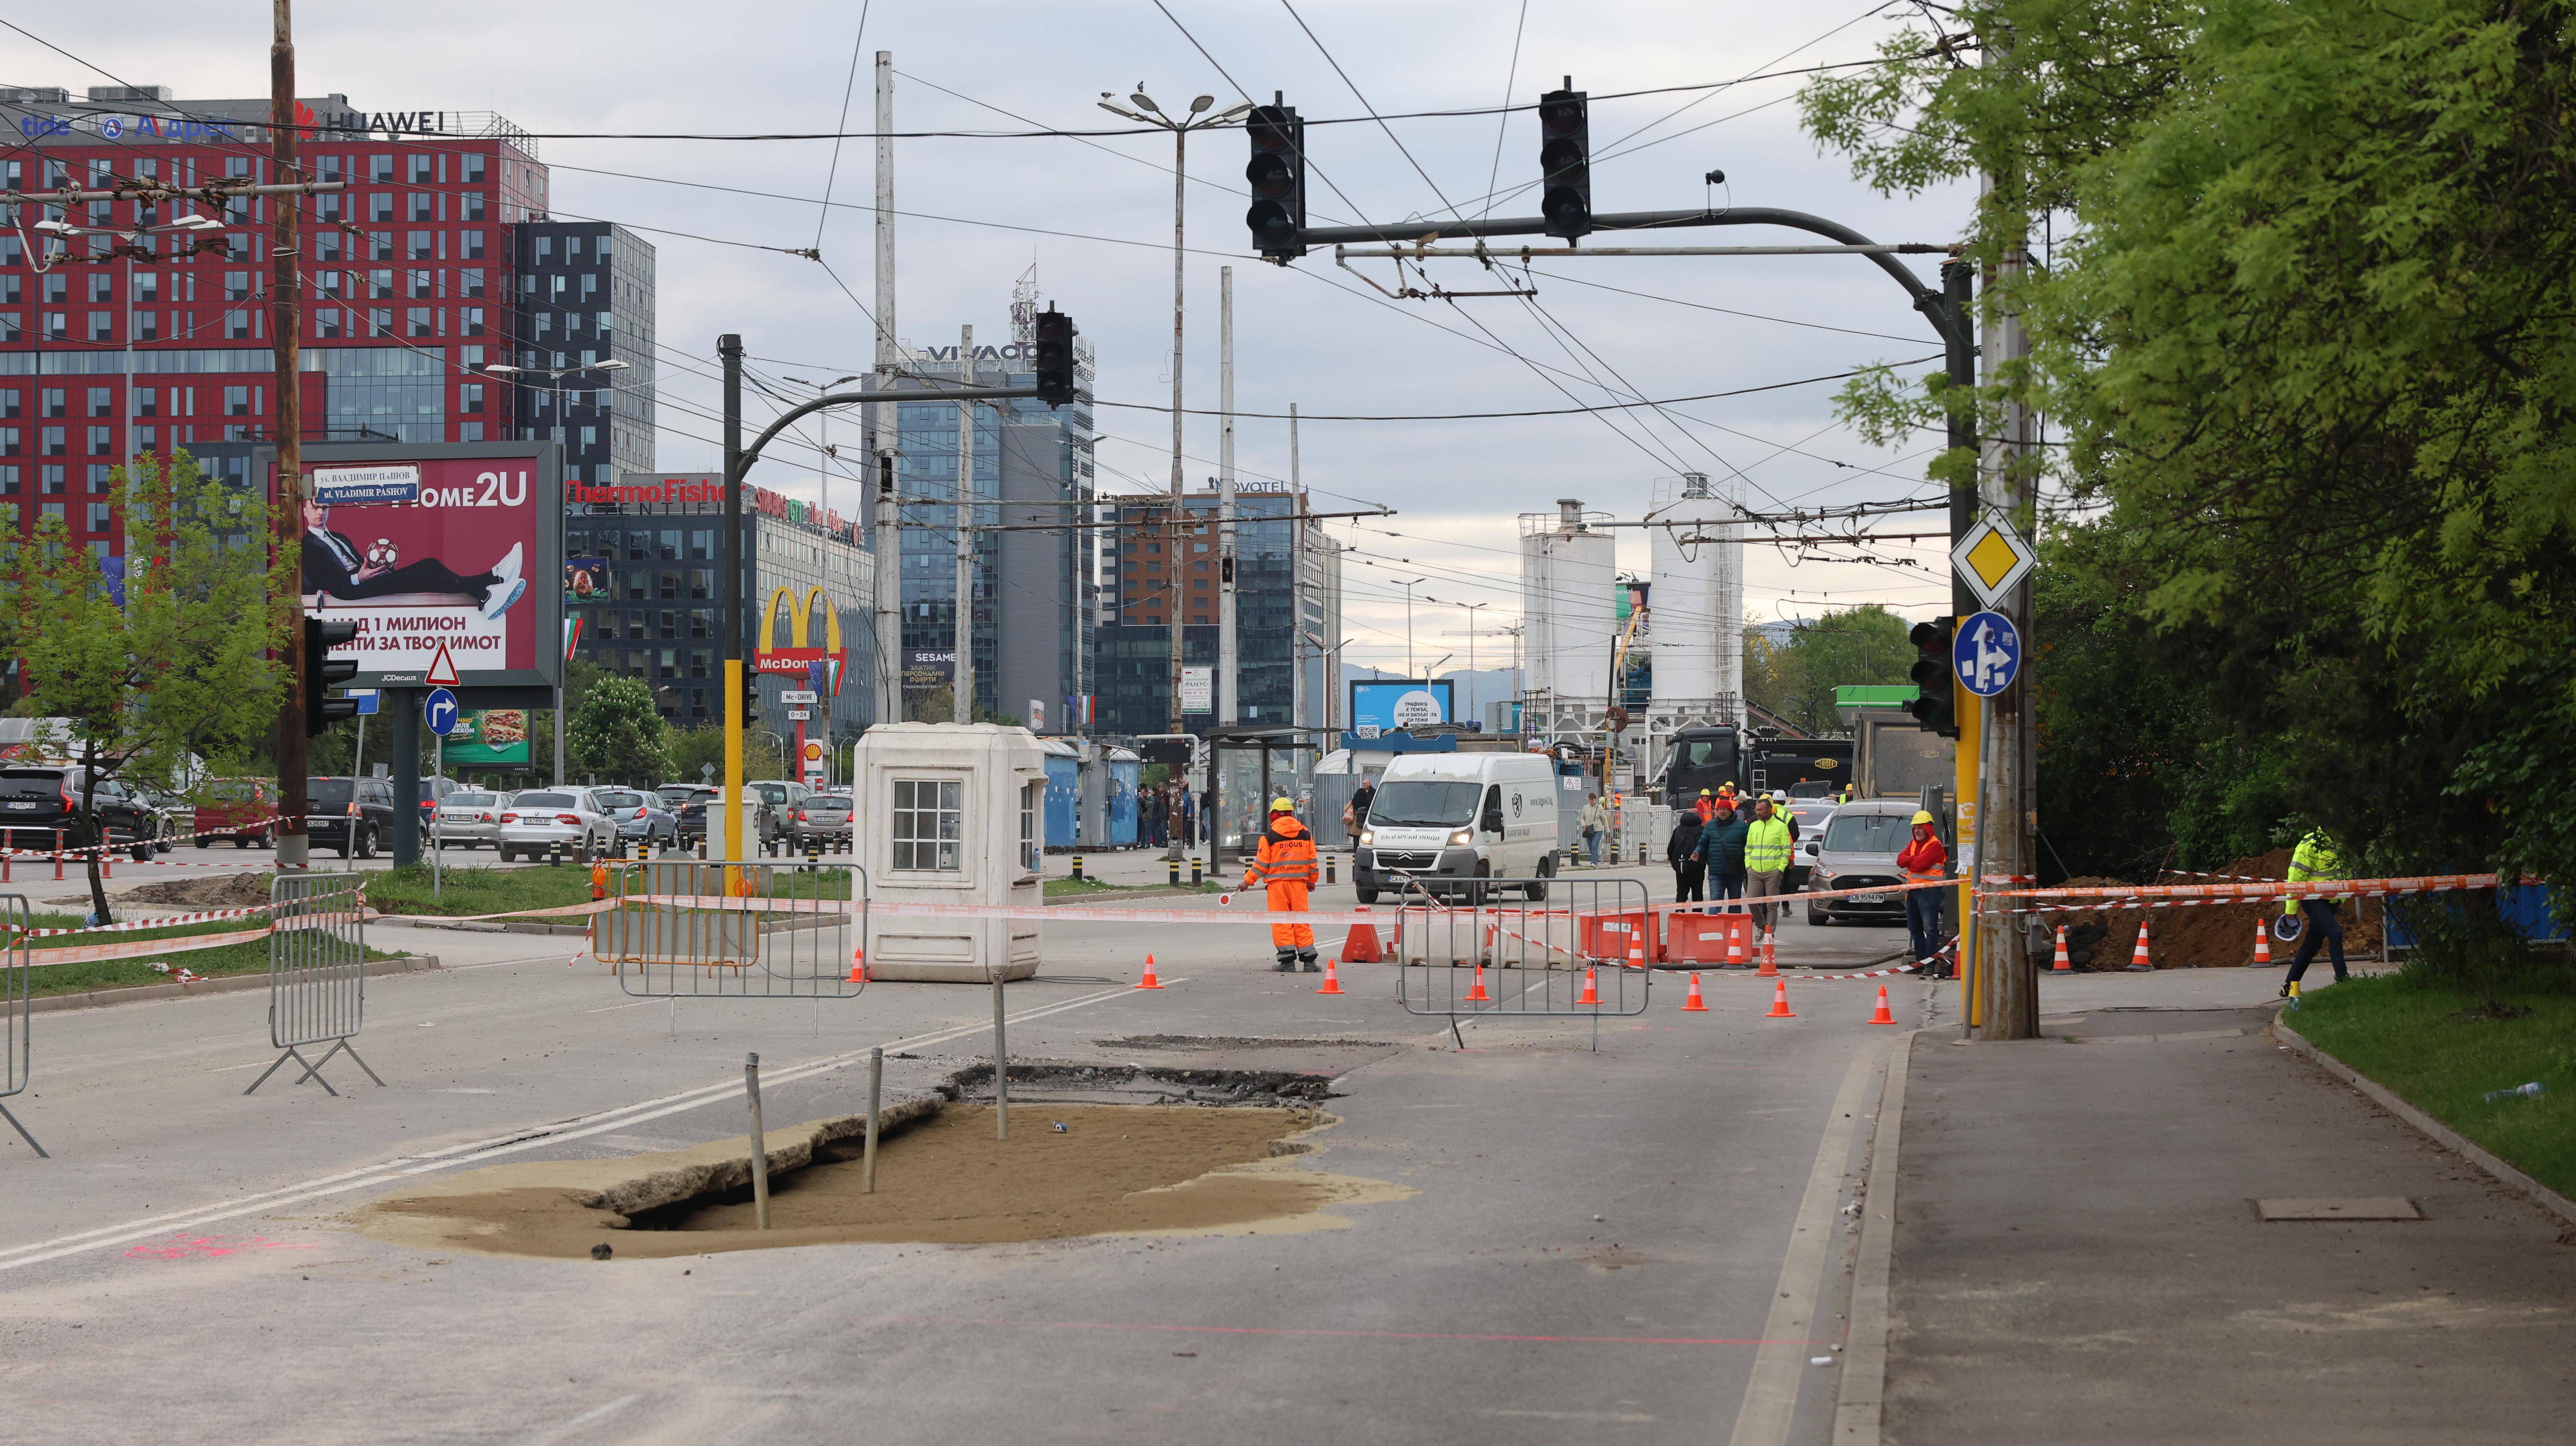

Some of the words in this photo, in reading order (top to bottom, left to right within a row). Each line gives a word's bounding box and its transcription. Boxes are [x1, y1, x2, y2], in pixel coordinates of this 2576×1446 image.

[21, 115, 70, 136] tide
[327, 111, 443, 131] HUAWEI
[927, 345, 1037, 361] VIVACO
[332, 473, 377, 483] ВЛАДИМИР
[324, 489, 333, 498] ul.
[334, 488, 375, 498] VLADIMIR
[376, 487, 408, 496] PASHOV
[392, 471, 527, 507] OME2U
[565, 502, 721, 516] SCIENTIFI
[374, 618, 380, 631] 1
[386, 617, 465, 631] МИЛИОН
[379, 636, 401, 650] ЗА
[451, 636, 501, 650] ИМОТ
[1816, 759, 1836, 768] MEILLER
